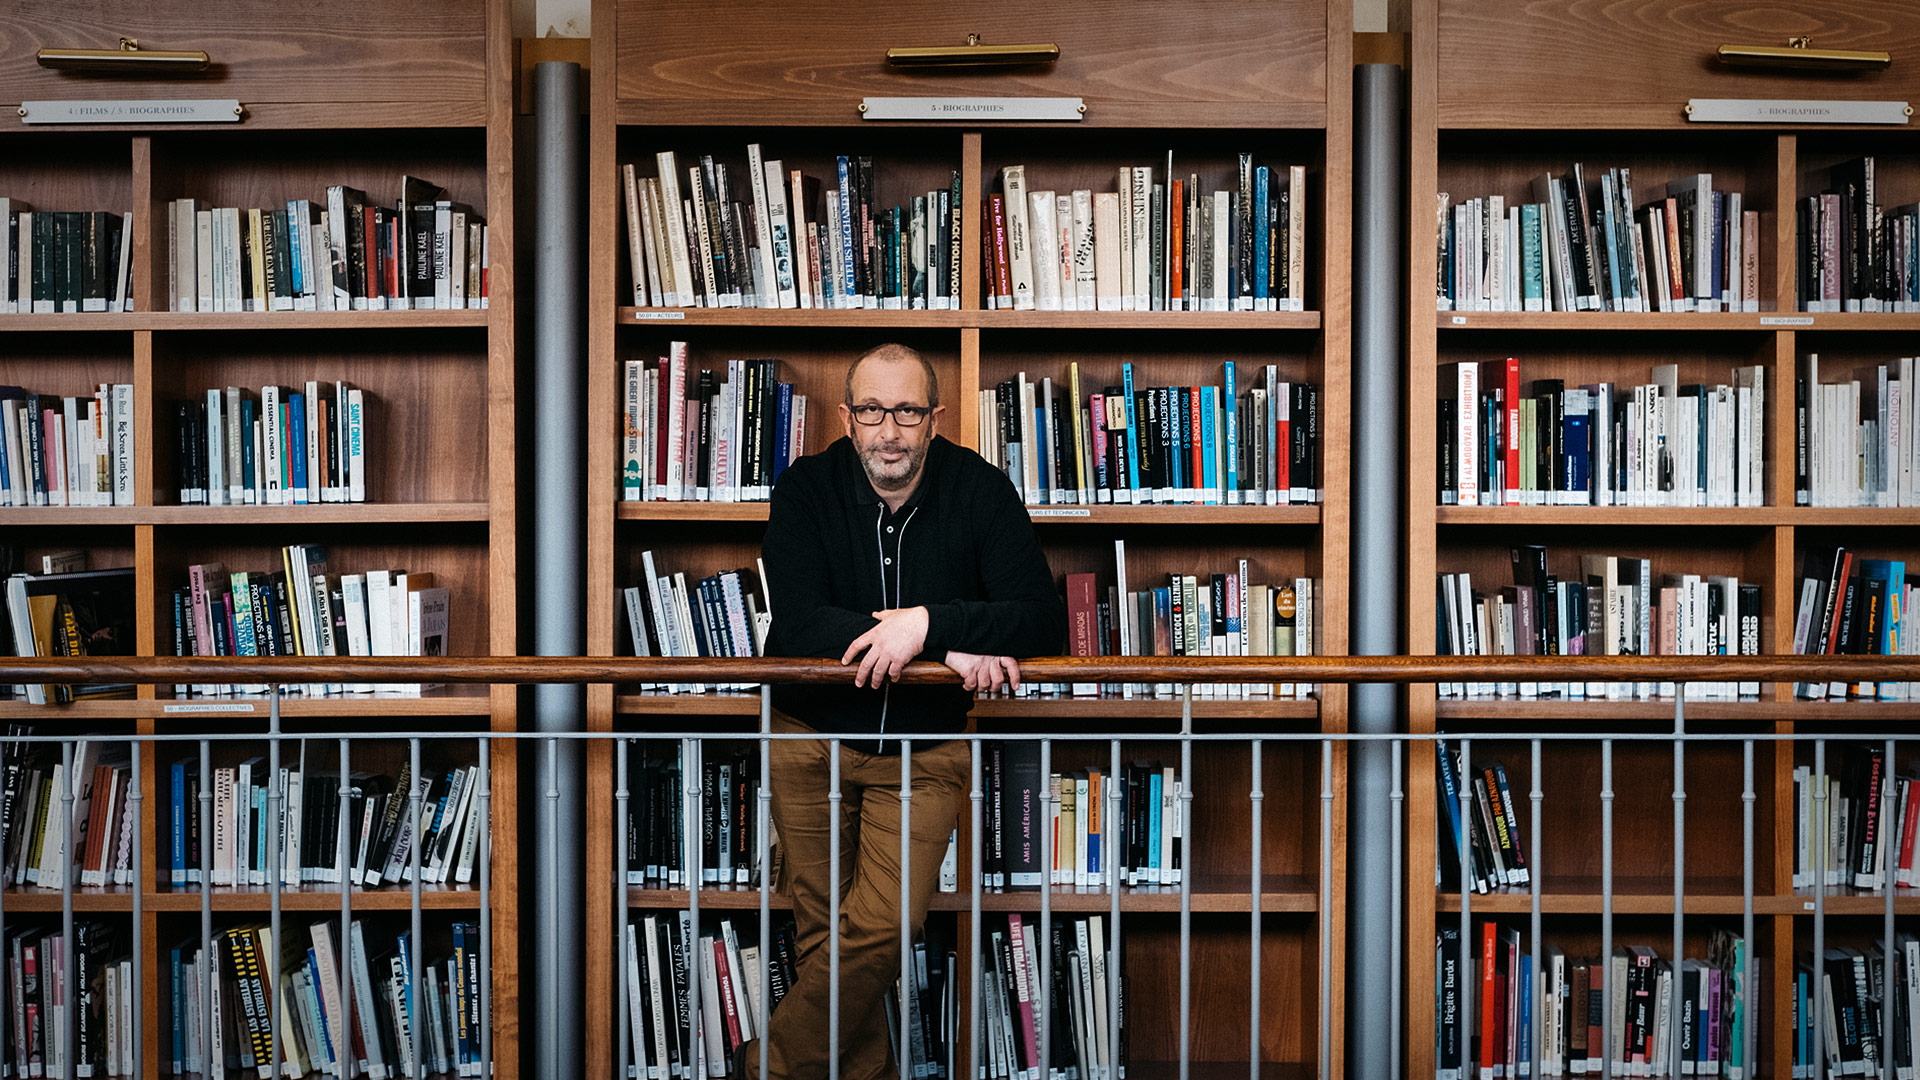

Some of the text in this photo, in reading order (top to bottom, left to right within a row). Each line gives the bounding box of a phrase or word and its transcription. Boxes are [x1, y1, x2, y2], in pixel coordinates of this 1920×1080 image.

[1568, 198, 1579, 244] AKERMAN
[996, 227, 1005, 264] Hollywood
[418, 254, 426, 280] PAULINE
[436, 254, 444, 280] PAULINE
[952, 241, 960, 296] HOLLYWOO
[1747, 254, 1756, 299] Woody Allen
[1826, 255, 1834, 294] WOODY
[629, 366, 637, 454] THE GREAT MOVIE STARS
[1148, 390, 1156, 419] Projections
[1160, 390, 1168, 438] PROJECTIONS
[1170, 391, 1179, 438] PROJECTIONS
[1890, 386, 1900, 447] ANTONIONI
[119, 421, 128, 433] Big
[350, 404, 360, 456] SAINT CINEMA
[119, 457, 128, 474] Little
[717, 440, 727, 486] VADIM
[250, 584, 264, 632] PROJECTIONS
[1172, 576, 1181, 604] SELZNICK
[65, 612, 76, 636] TAXI
[1174, 613, 1182, 650] HITCHCOCK
[1841, 586, 1854, 646] MICHEL AUDIARD
[1241, 636, 1248, 645] Le
[1441, 757, 1451, 779] AVERY
[445, 771, 463, 814] PROJECTIONS
[1485, 769, 1510, 849] AZNAVOUR PAR AZNAVOUR
[1502, 789, 1516, 827] AZNAVOUR
[1009, 922, 1022, 937] LIFE
[674, 944, 690, 1028] FEMMES FATALES
[1014, 947, 1028, 1003] HOLLYWOOD
[1445, 960, 1456, 1024] Brigitte Bardot
[239, 978, 254, 1016] ESTRELLAS
[251, 979, 266, 1016] ESTRELLAS
[722, 976, 734, 1016] TOURNAGES
[1683, 1000, 1691, 1023] Bazin
[247, 1018, 258, 1032] LAS
[258, 1018, 270, 1032] LAS
[1846, 1007, 1856, 1045] GLOIRE
